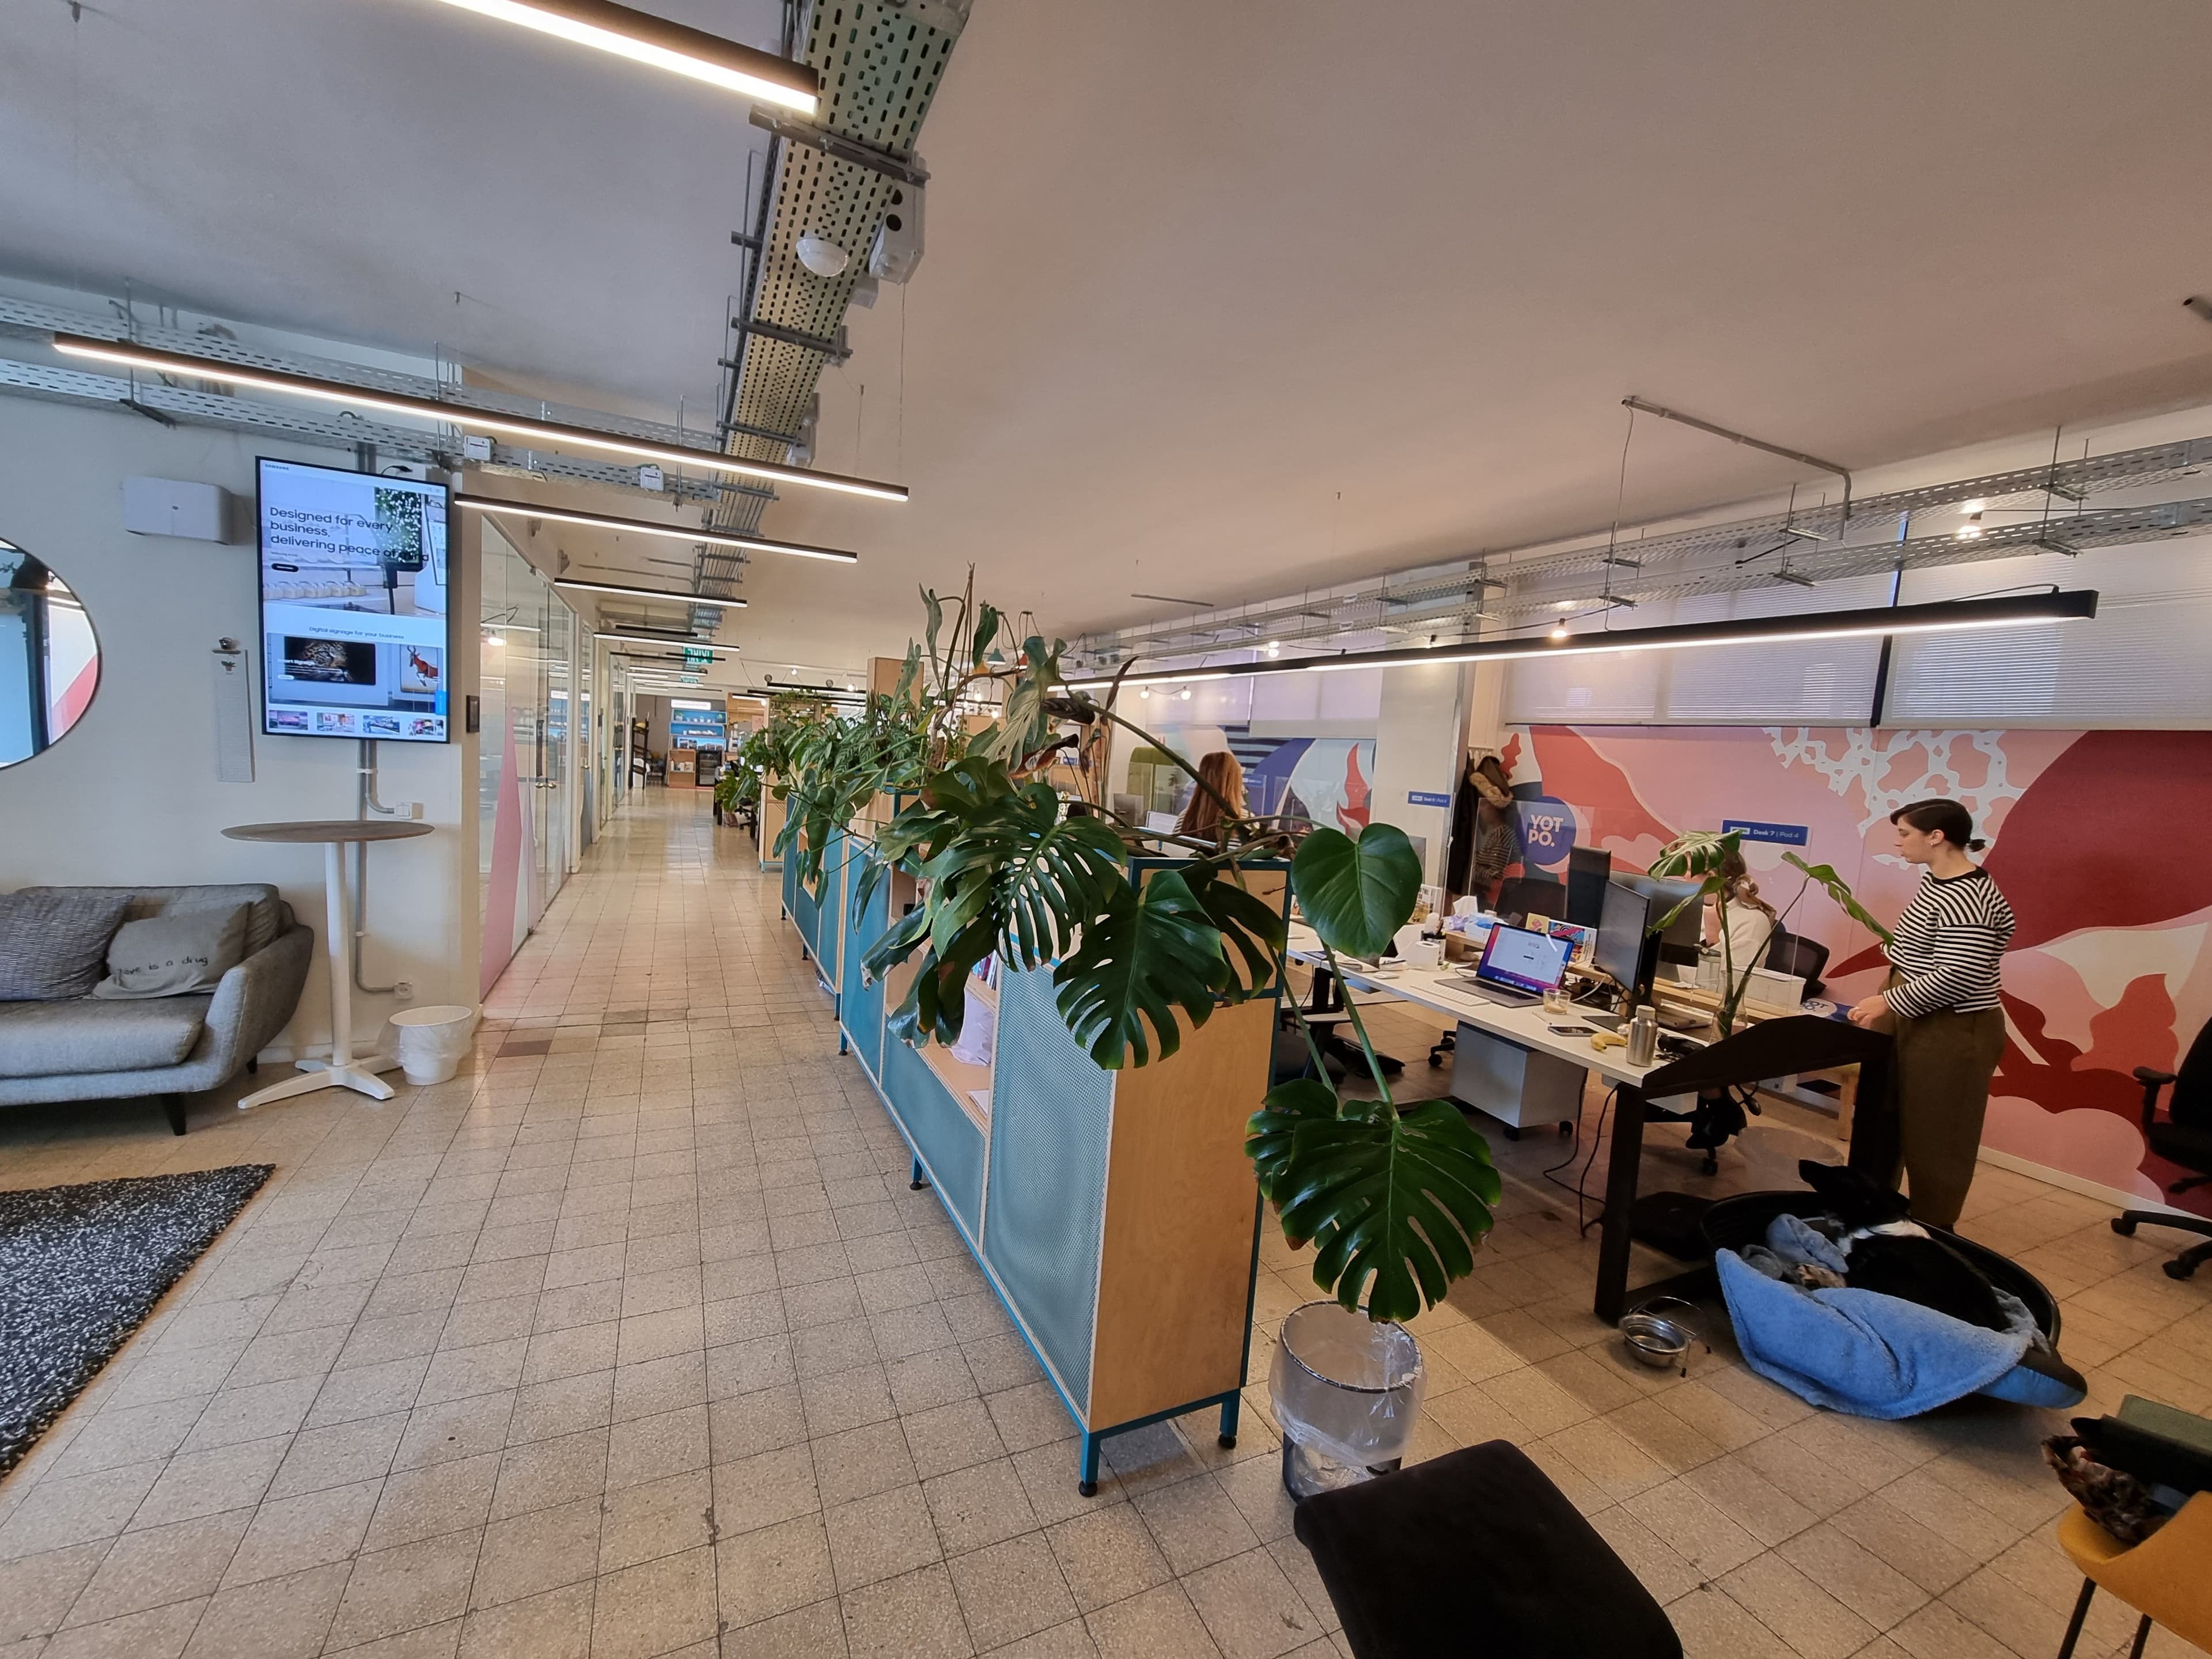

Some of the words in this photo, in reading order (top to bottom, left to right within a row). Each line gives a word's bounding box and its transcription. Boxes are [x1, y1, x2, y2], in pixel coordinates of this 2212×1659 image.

[270, 507, 332, 524] Designed
[335, 514, 354, 526] for
[357, 520, 393, 533] every
[270, 521, 331, 537] business,
[271, 535, 336, 553] delivering
[339, 544, 380, 556] peace
[383, 548, 396, 558] of
[1530, 814, 1564, 832] YOT
[1528, 828, 1555, 847] PO.
[149, 962, 160, 970] is
